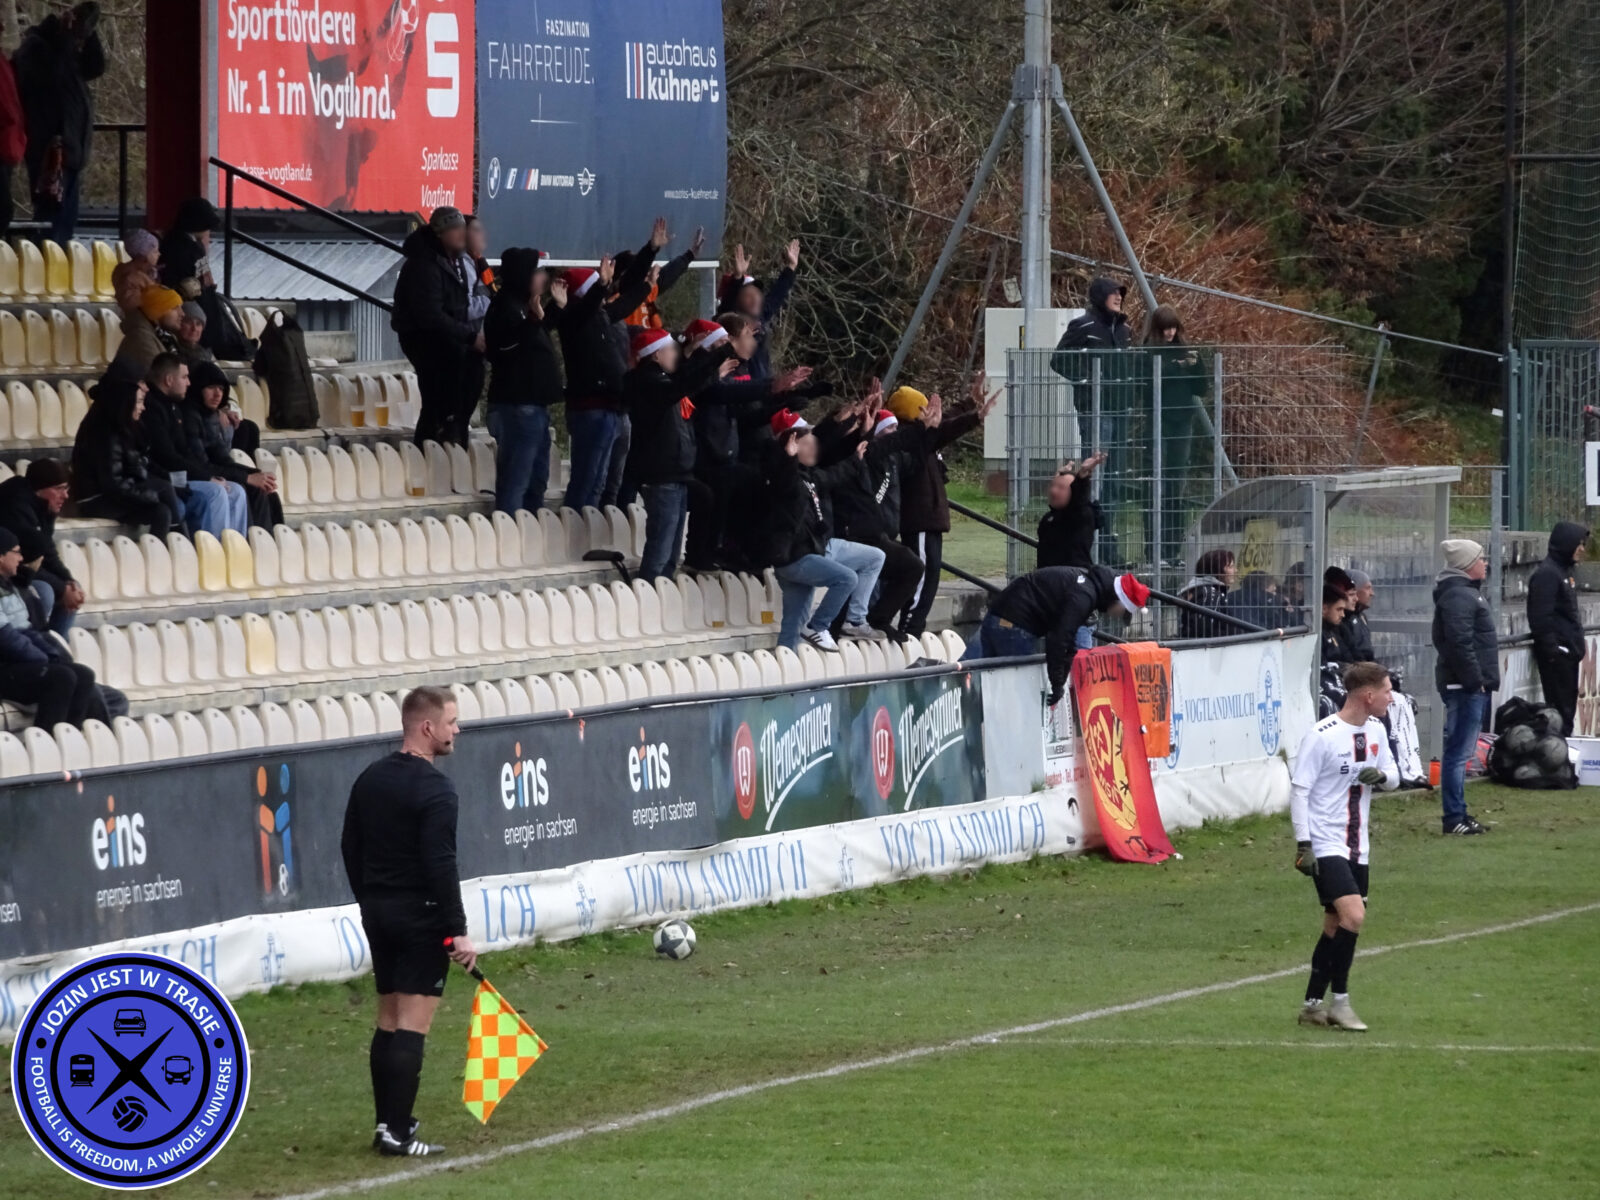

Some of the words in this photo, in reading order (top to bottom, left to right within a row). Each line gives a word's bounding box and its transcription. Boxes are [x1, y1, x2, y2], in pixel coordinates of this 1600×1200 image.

[545, 19, 590, 38] FASZINATION
[488, 41, 595, 85] FAHRFREUDE.
[646, 38, 717, 68] autohaus
[228, 68, 252, 114] Nr.
[258, 70, 271, 115] 1
[278, 67, 306, 116] im
[647, 68, 720, 103] kühnert
[421, 146, 459, 176] Sparkasse
[1185, 691, 1256, 723] VOGTLANDMILCH
[760, 697, 833, 813] Wernesgrüner
[898, 681, 963, 794] Wernesgrüner
[501, 741, 550, 810] eins
[628, 726, 671, 793] eins
[92, 795, 147, 870] eins
[504, 819, 535, 848] energie
[536, 817, 545, 840] in
[546, 813, 578, 836] sachsen
[632, 803, 658, 830] energie
[659, 802, 668, 821] in
[668, 796, 698, 820] sachsen
[96, 880, 132, 912] energie
[132, 878, 143, 903] in
[144, 873, 183, 901] sachsen
